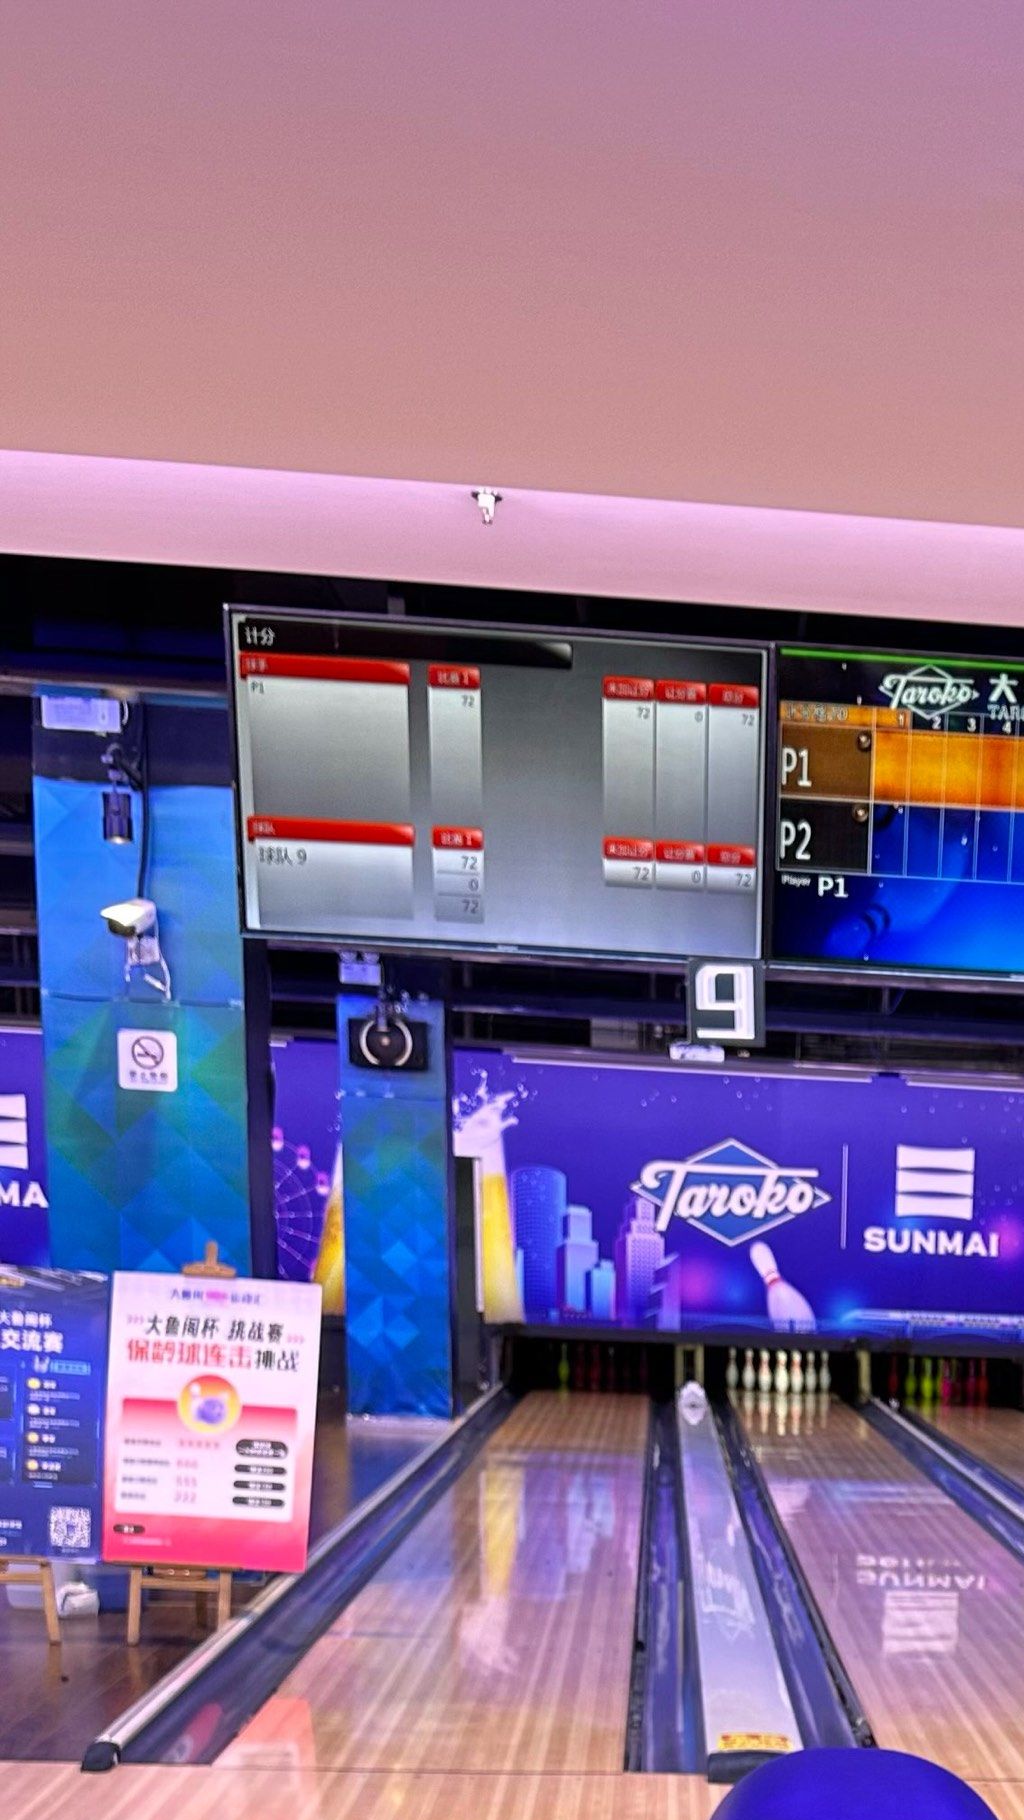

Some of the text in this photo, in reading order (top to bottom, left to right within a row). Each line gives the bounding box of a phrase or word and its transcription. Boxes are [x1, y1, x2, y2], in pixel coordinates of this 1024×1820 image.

[931, 716, 941, 730] 2
[967, 717, 977, 732] 3
[1002, 721, 1012, 734] 4
[780, 747, 812, 788] P1
[780, 820, 812, 861] P2
[296, 847, 307, 866] 9
[462, 856, 478, 870] 72
[634, 866, 650, 881] 72
[691, 870, 702, 884] 0
[736, 873, 752, 888] 72
[468, 879, 479, 891] 0
[818, 876, 849, 898] P1
[462, 899, 479, 914] 72
[695, 965, 757, 1041] 9
[639, 1161, 820, 1233] Taroko
[864, 1227, 1000, 1258] SUNMAI
[145, 1314, 284, 1343] 大鲁阁杯 挑战赛
